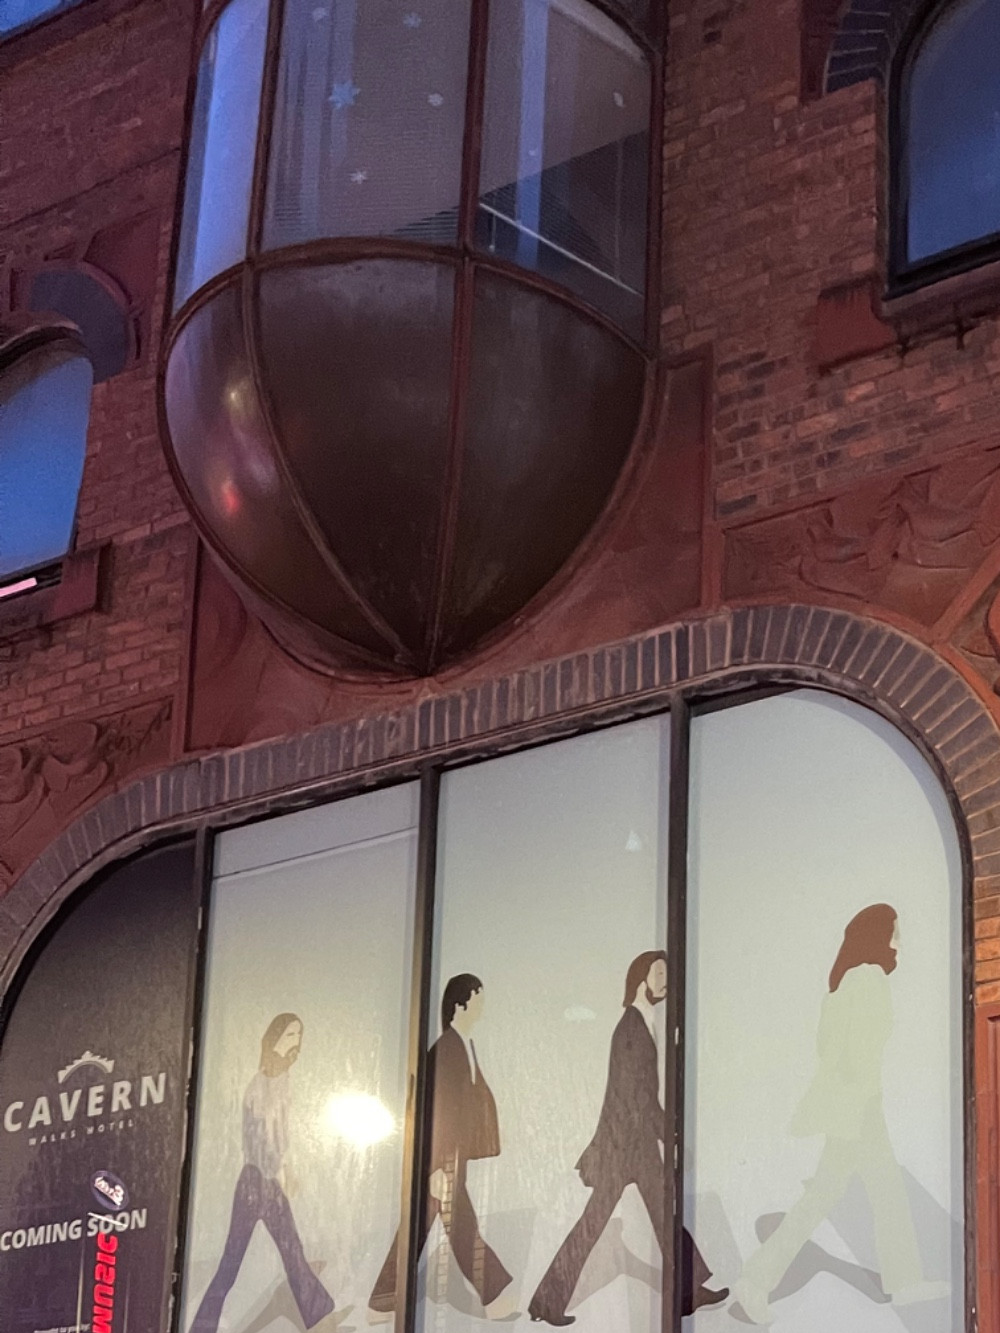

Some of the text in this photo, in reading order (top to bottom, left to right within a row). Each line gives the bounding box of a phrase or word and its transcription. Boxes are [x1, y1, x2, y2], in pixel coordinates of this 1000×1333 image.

[4, 1073, 166, 1132] CAVERN
[29, 1119, 135, 1146] WALKS HOTEL
[1, 1208, 147, 1251] COMING SOON
